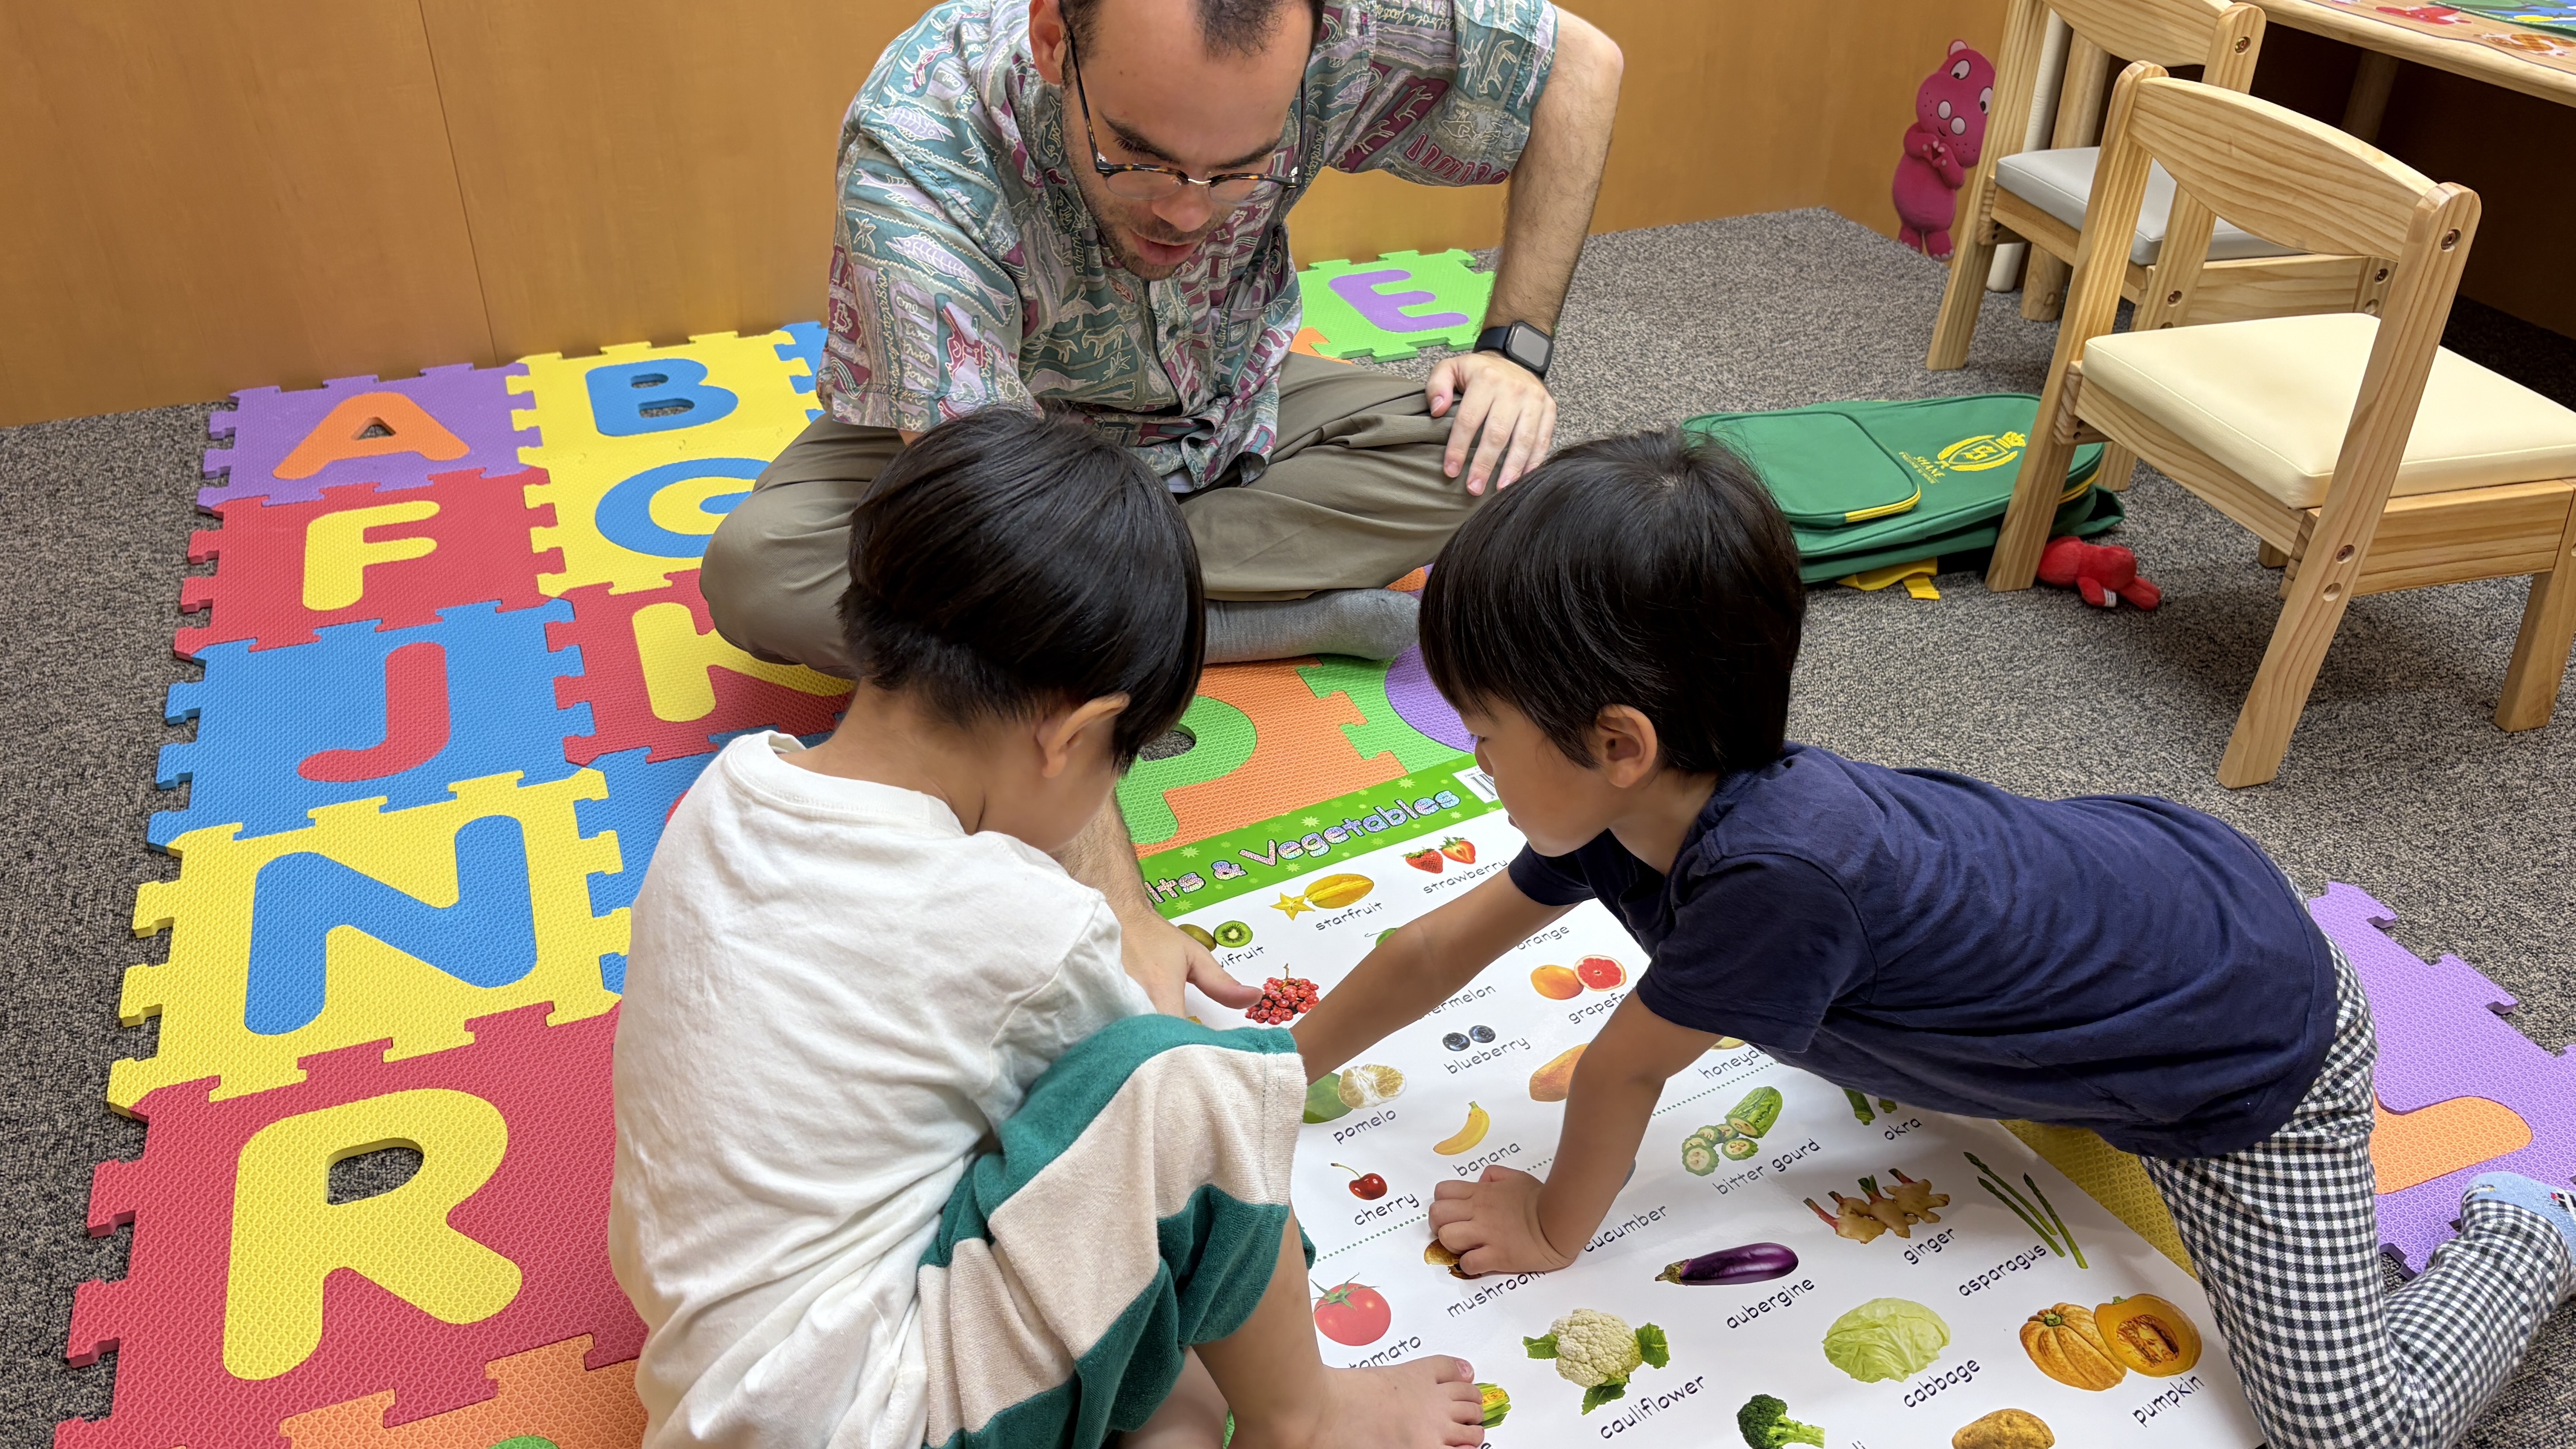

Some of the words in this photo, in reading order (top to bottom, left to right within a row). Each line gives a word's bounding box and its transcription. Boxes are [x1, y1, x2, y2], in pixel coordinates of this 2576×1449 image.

[1328, 269, 1469, 332] E
[273, 391, 470, 480] A
[585, 359, 739, 437] B
[303, 501, 440, 611] F
[298, 643, 451, 781] J
[1144, 872, 1206, 903] its
[1212, 860, 1248, 881] &
[1239, 790, 1462, 867] Vegetables
[244, 814, 538, 1036] N
[1316, 902, 1383, 930] starfruit
[1517, 925, 1570, 950] orange
[1423, 984, 1496, 1018] ermelon
[1569, 992, 1628, 1024] grapefr
[1444, 1037, 1531, 1074] blueberry
[1333, 1110, 1397, 1144] pomelo
[1884, 1117, 1923, 1141] okra
[1453, 1142, 1522, 1177] banana
[1712, 1164, 1763, 1195] bitter
[1771, 1138, 1822, 1172] gourd
[1354, 1193, 1420, 1225] cherry
[1583, 1205, 1667, 1253] cucumber
[1903, 1226, 1955, 1265] ginger
[1959, 1243, 2047, 1297] asparagus
[1726, 1278, 1815, 1329] aubergine
[1600, 1373, 1706, 1440] cauliflower
[1903, 1357, 1981, 1410] cabbage
[2132, 1373, 2205, 1429] pumpkin
